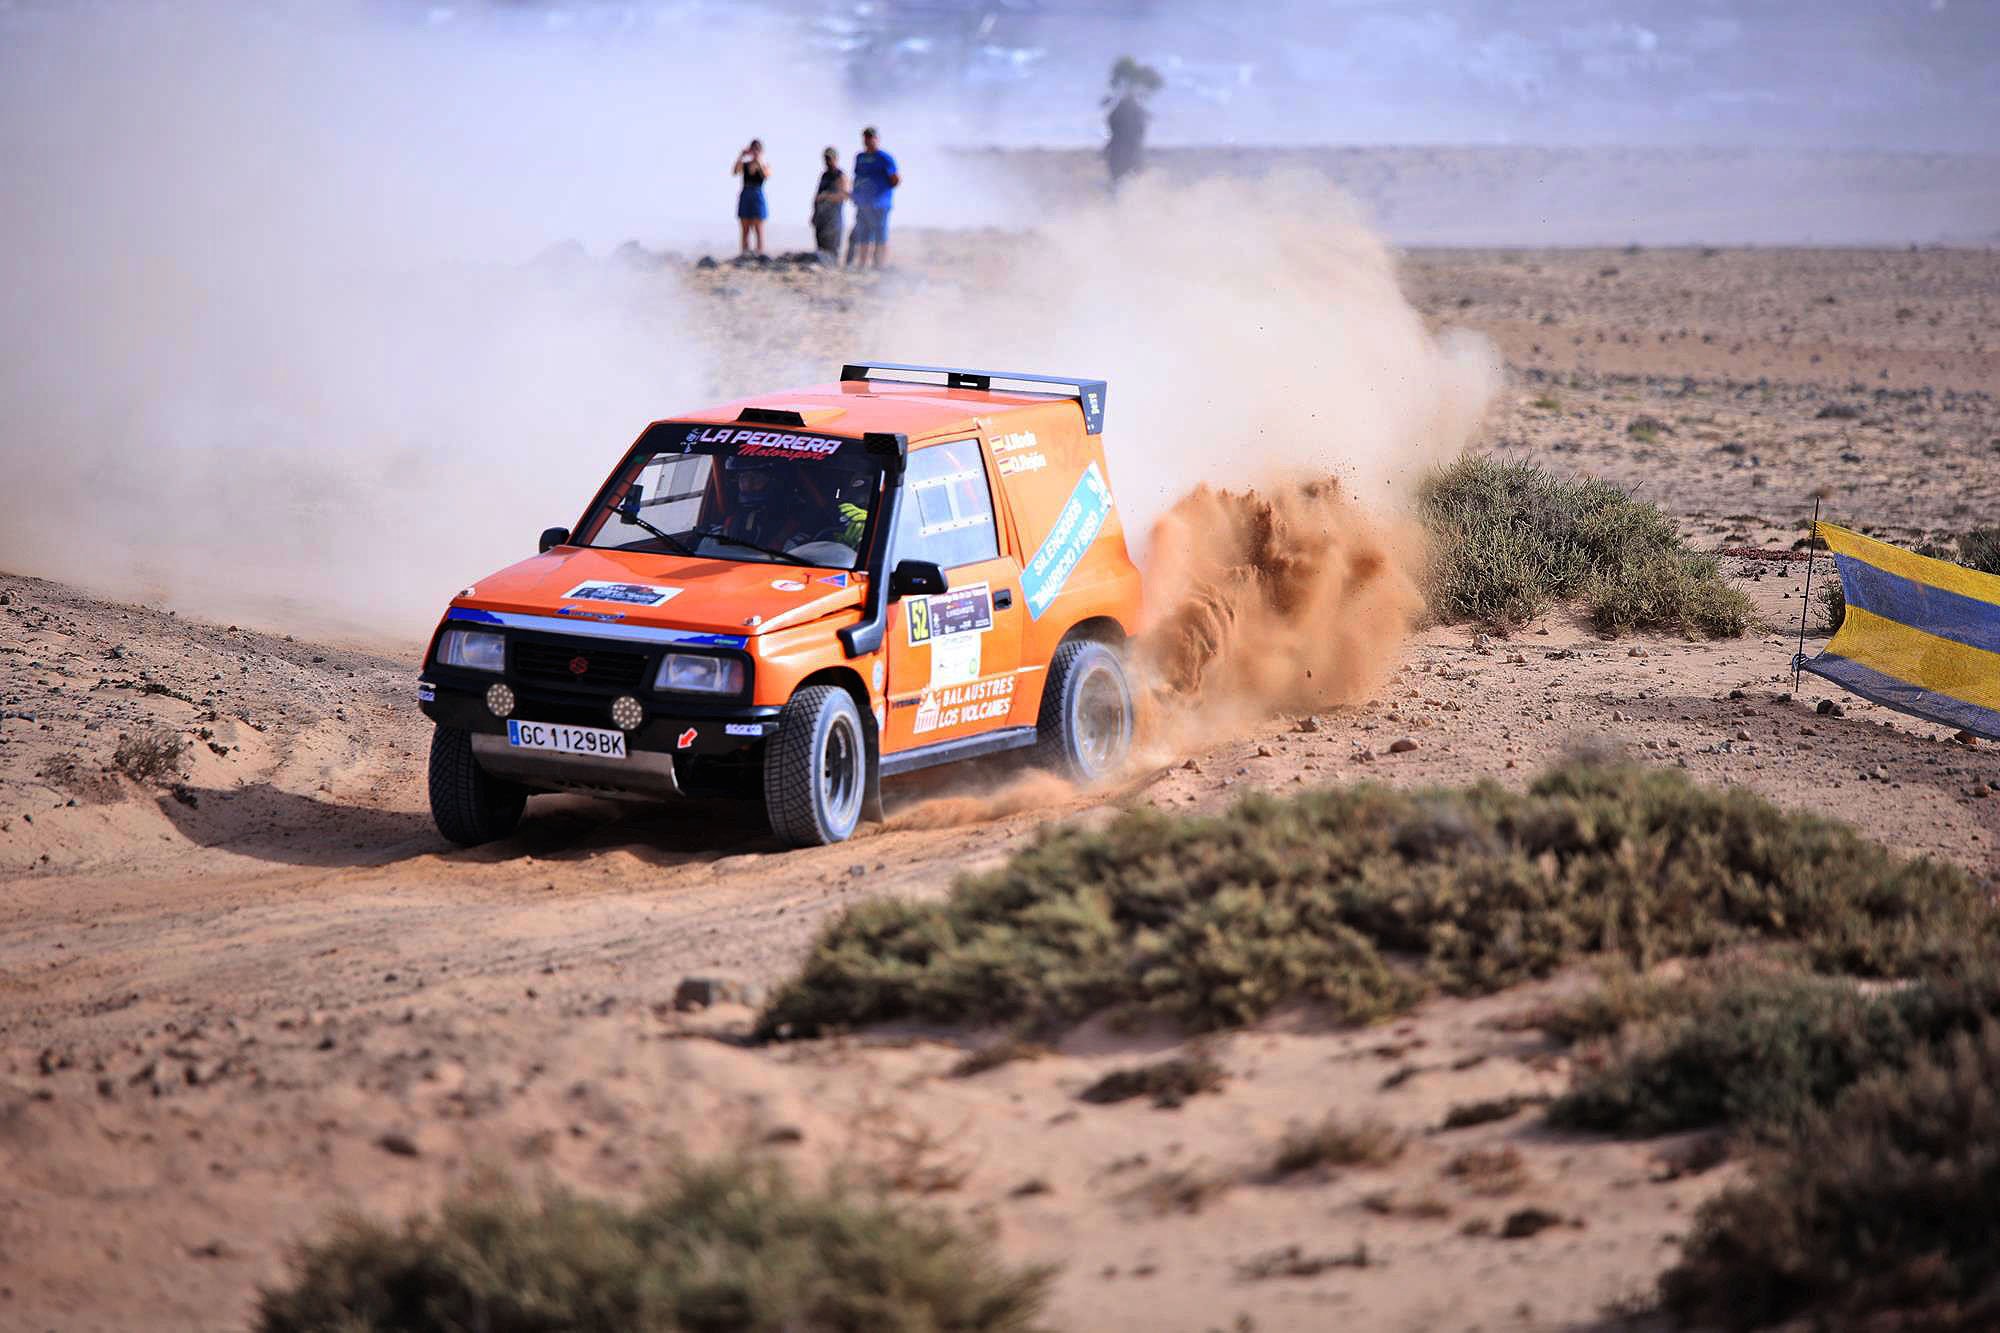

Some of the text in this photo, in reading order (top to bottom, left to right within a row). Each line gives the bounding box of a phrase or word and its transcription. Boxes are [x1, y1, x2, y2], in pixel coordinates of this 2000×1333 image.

[700, 428, 734, 443] LA
[731, 430, 843, 455] PEDRERA
[737, 443, 828, 462] Motorsport
[911, 600, 929, 640] 52
[943, 676, 1016, 707] BALAUSTRES
[938, 697, 1012, 728] LOS VOLCANES
[520, 724, 624, 756] GC 1129 BK
